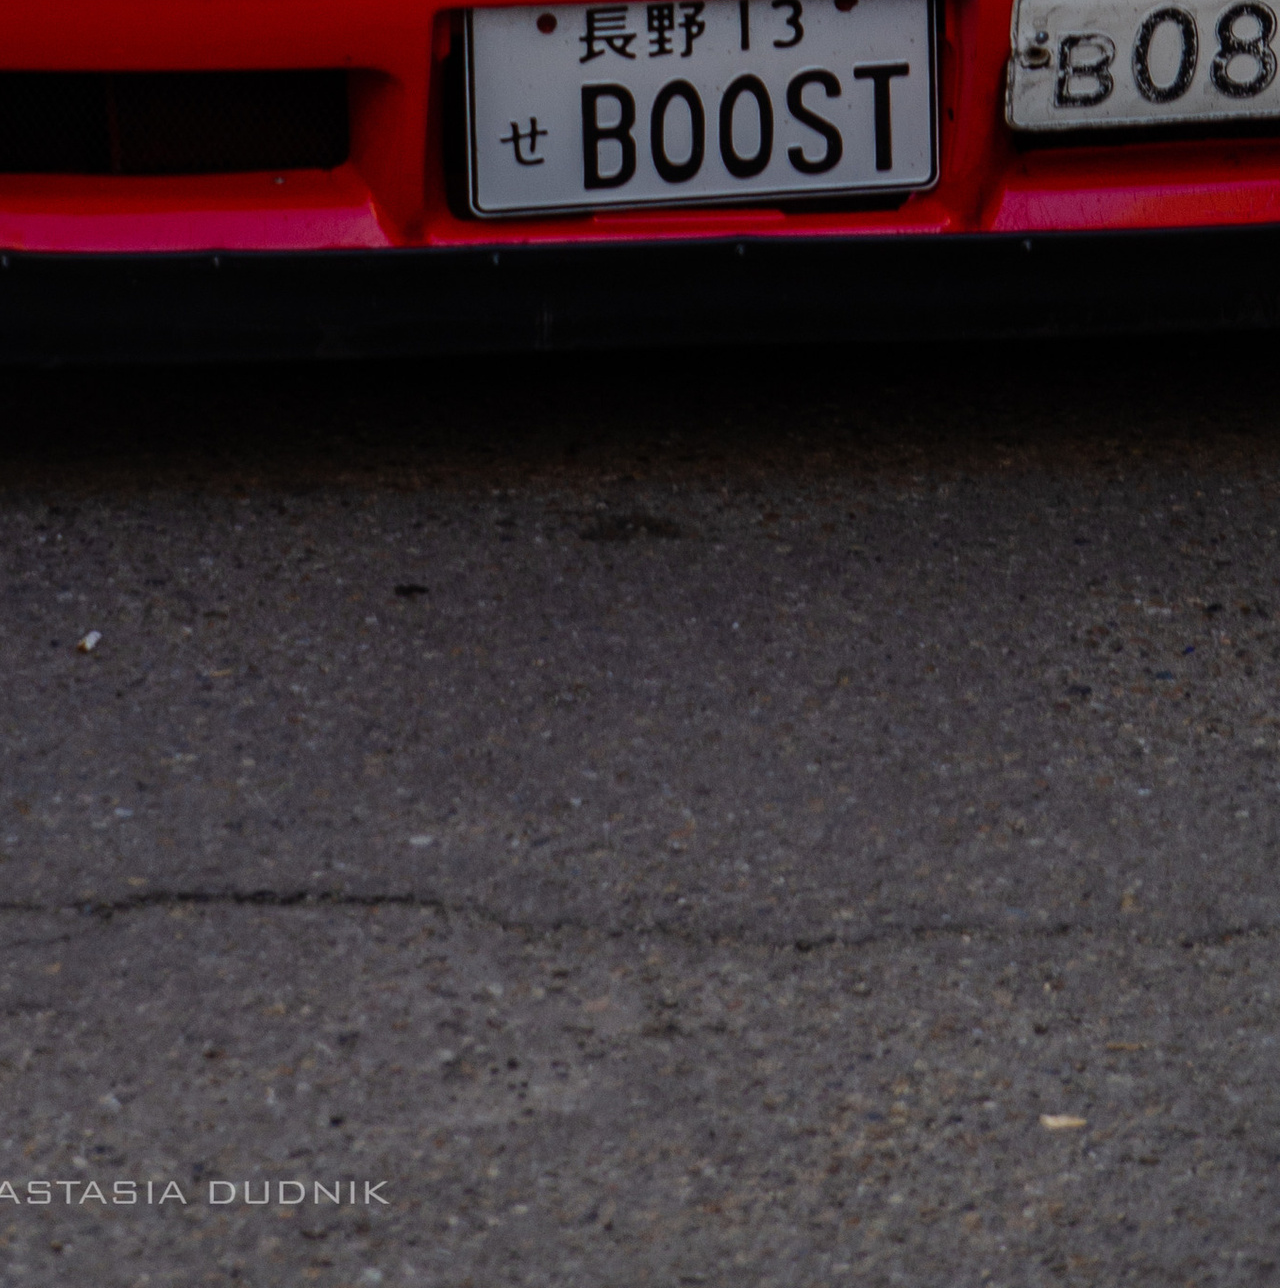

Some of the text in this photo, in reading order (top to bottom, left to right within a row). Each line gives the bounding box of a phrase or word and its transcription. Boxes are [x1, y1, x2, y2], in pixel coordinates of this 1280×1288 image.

[579, 0, 706, 63] 長野
[499, 116, 549, 166] せ
[580, 61, 911, 190] BOOST
